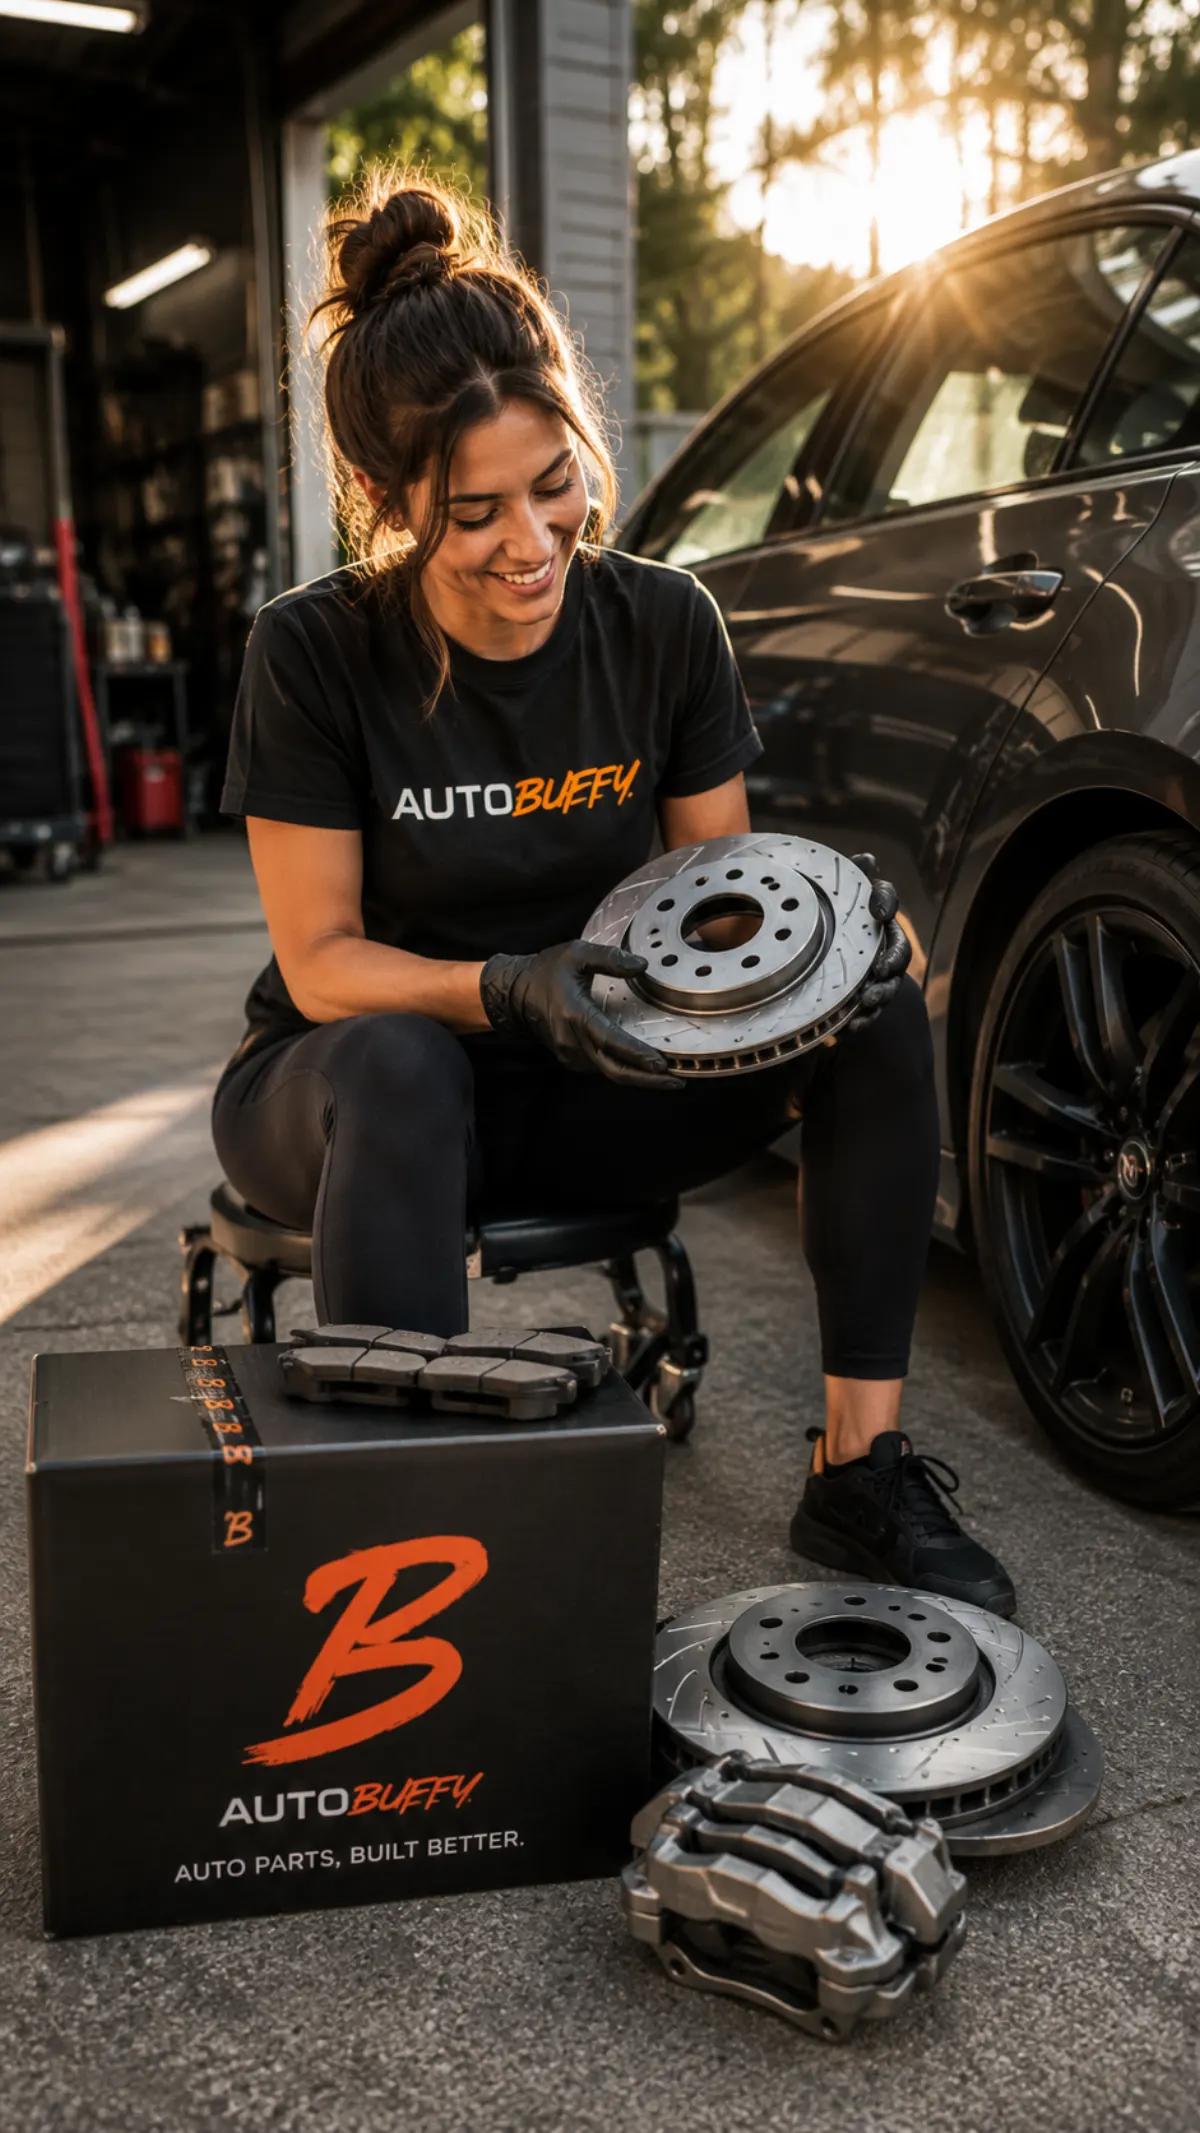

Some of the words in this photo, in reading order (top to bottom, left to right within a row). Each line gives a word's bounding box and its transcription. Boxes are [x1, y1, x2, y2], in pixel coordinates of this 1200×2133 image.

[223, 1510, 254, 1548] B
[241, 1535, 489, 1767] B
[174, 1859, 247, 1884] AUTO
[254, 1850, 342, 1877] PARTS,
[350, 1840, 419, 1866] BUILT
[426, 1830, 525, 1857] BETTER.
